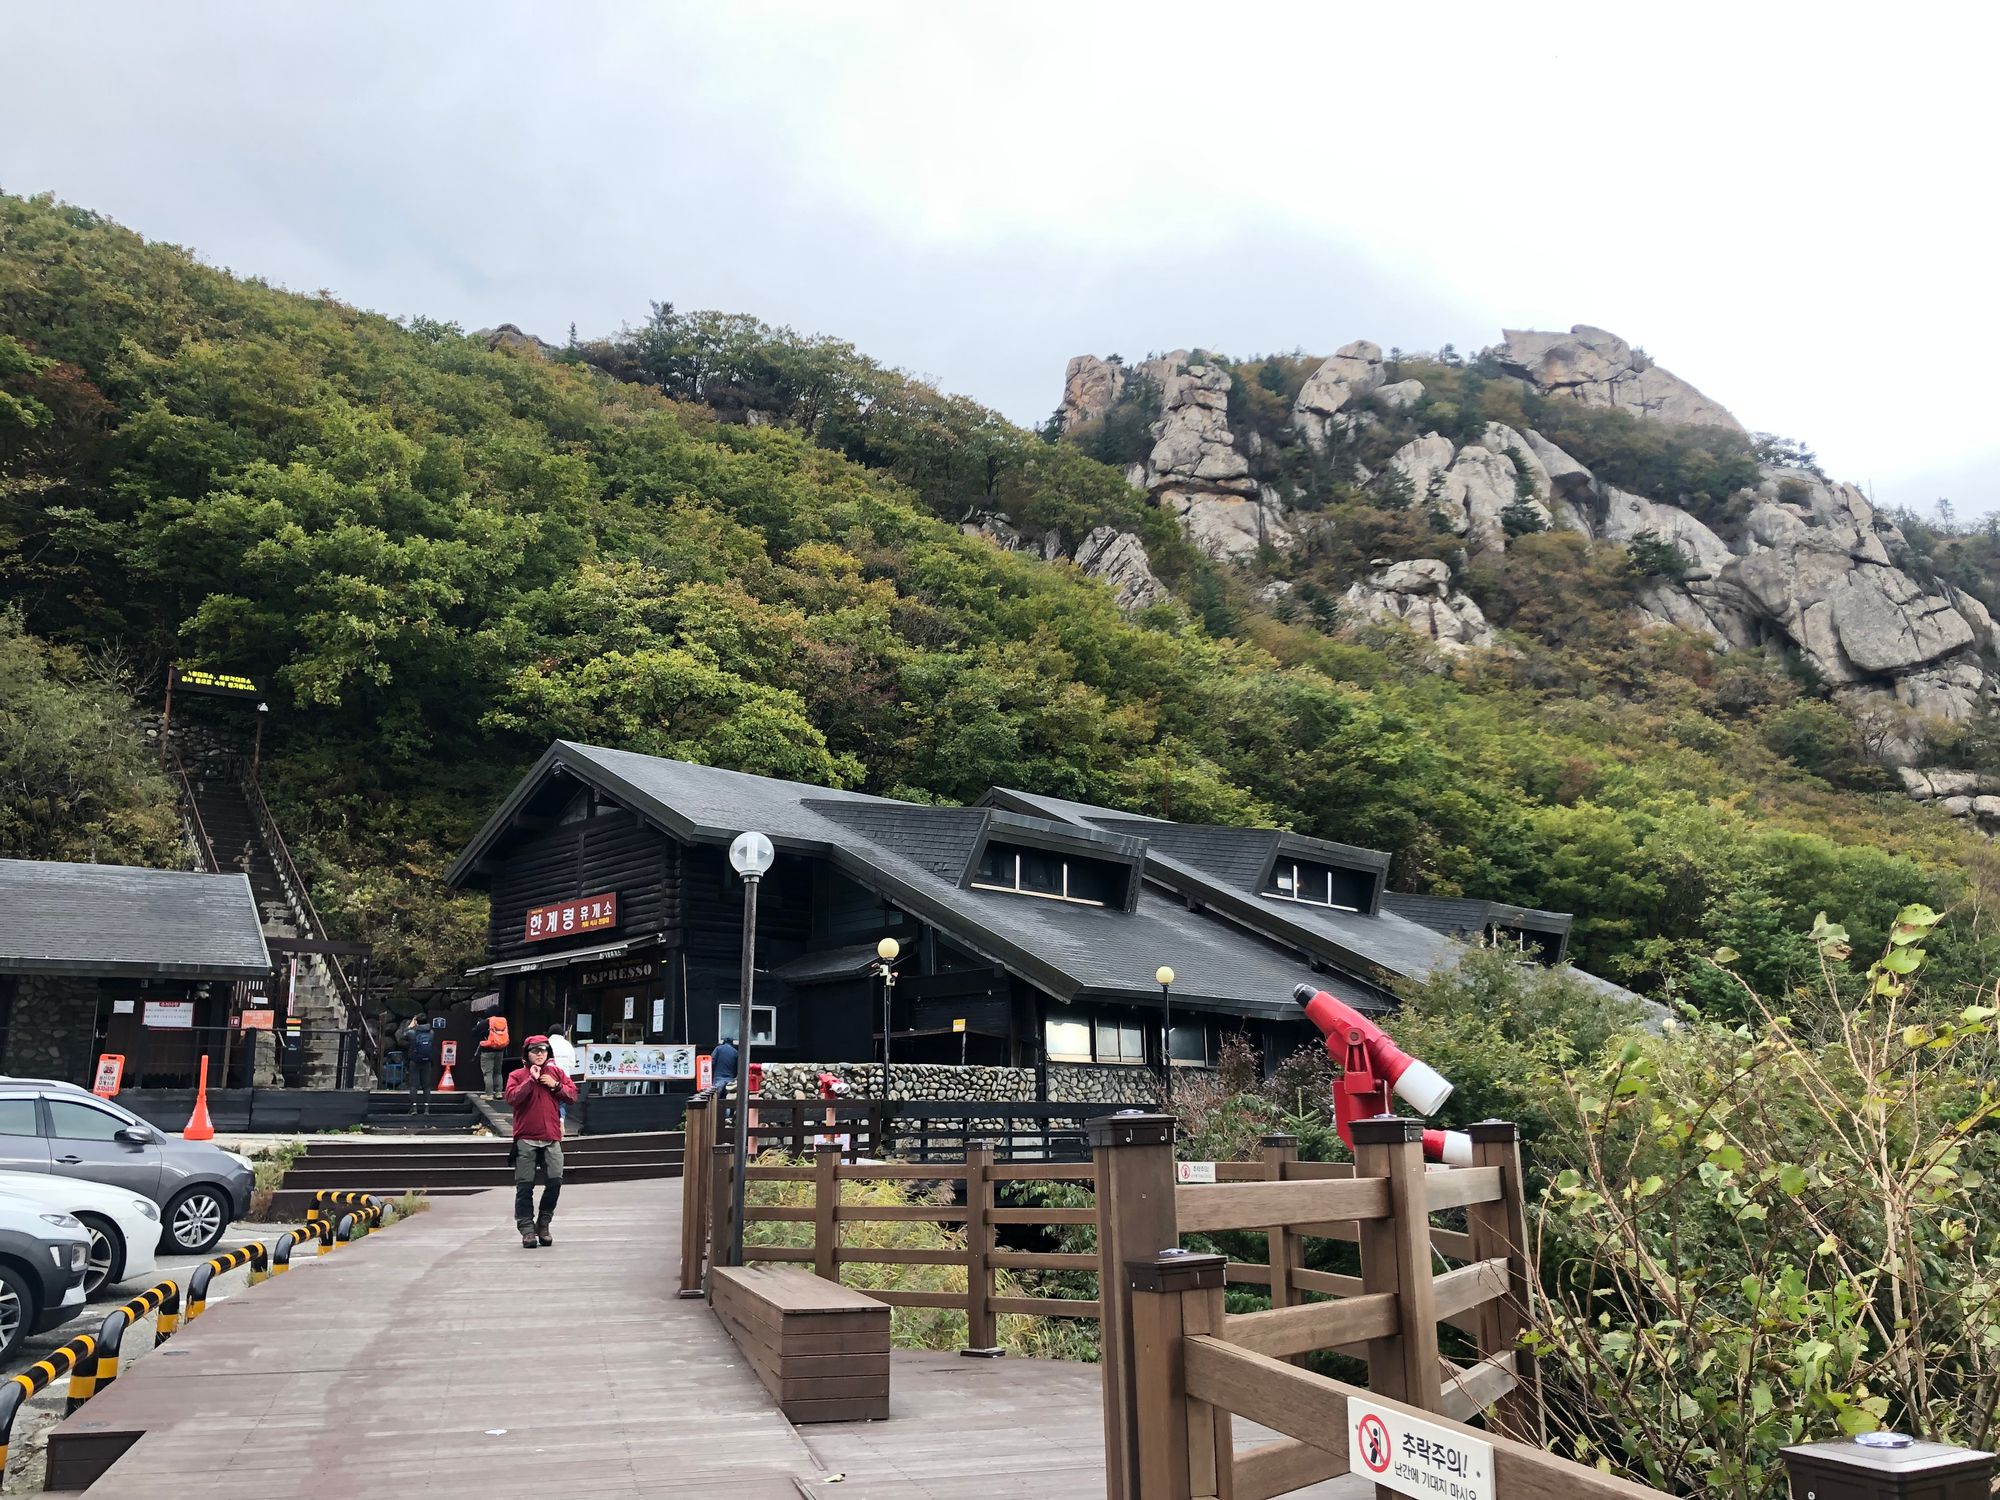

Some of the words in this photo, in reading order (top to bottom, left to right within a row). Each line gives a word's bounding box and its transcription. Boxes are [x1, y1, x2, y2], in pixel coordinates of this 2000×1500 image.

[530, 907, 575, 936] 한계령
[580, 901, 613, 920] 휴게소
[582, 964, 652, 985] ESPRESSO
[589, 1063, 616, 1076] 한방차
[617, 1063, 640, 1075] 옥수수
[642, 1062, 667, 1076] 생마즙
[673, 1061, 690, 1075] 칡즙
[1402, 1432, 1468, 1479] 추락주의!
[1394, 1461, 1419, 1484] 난간에
[1421, 1471, 1447, 1495] 기대지
